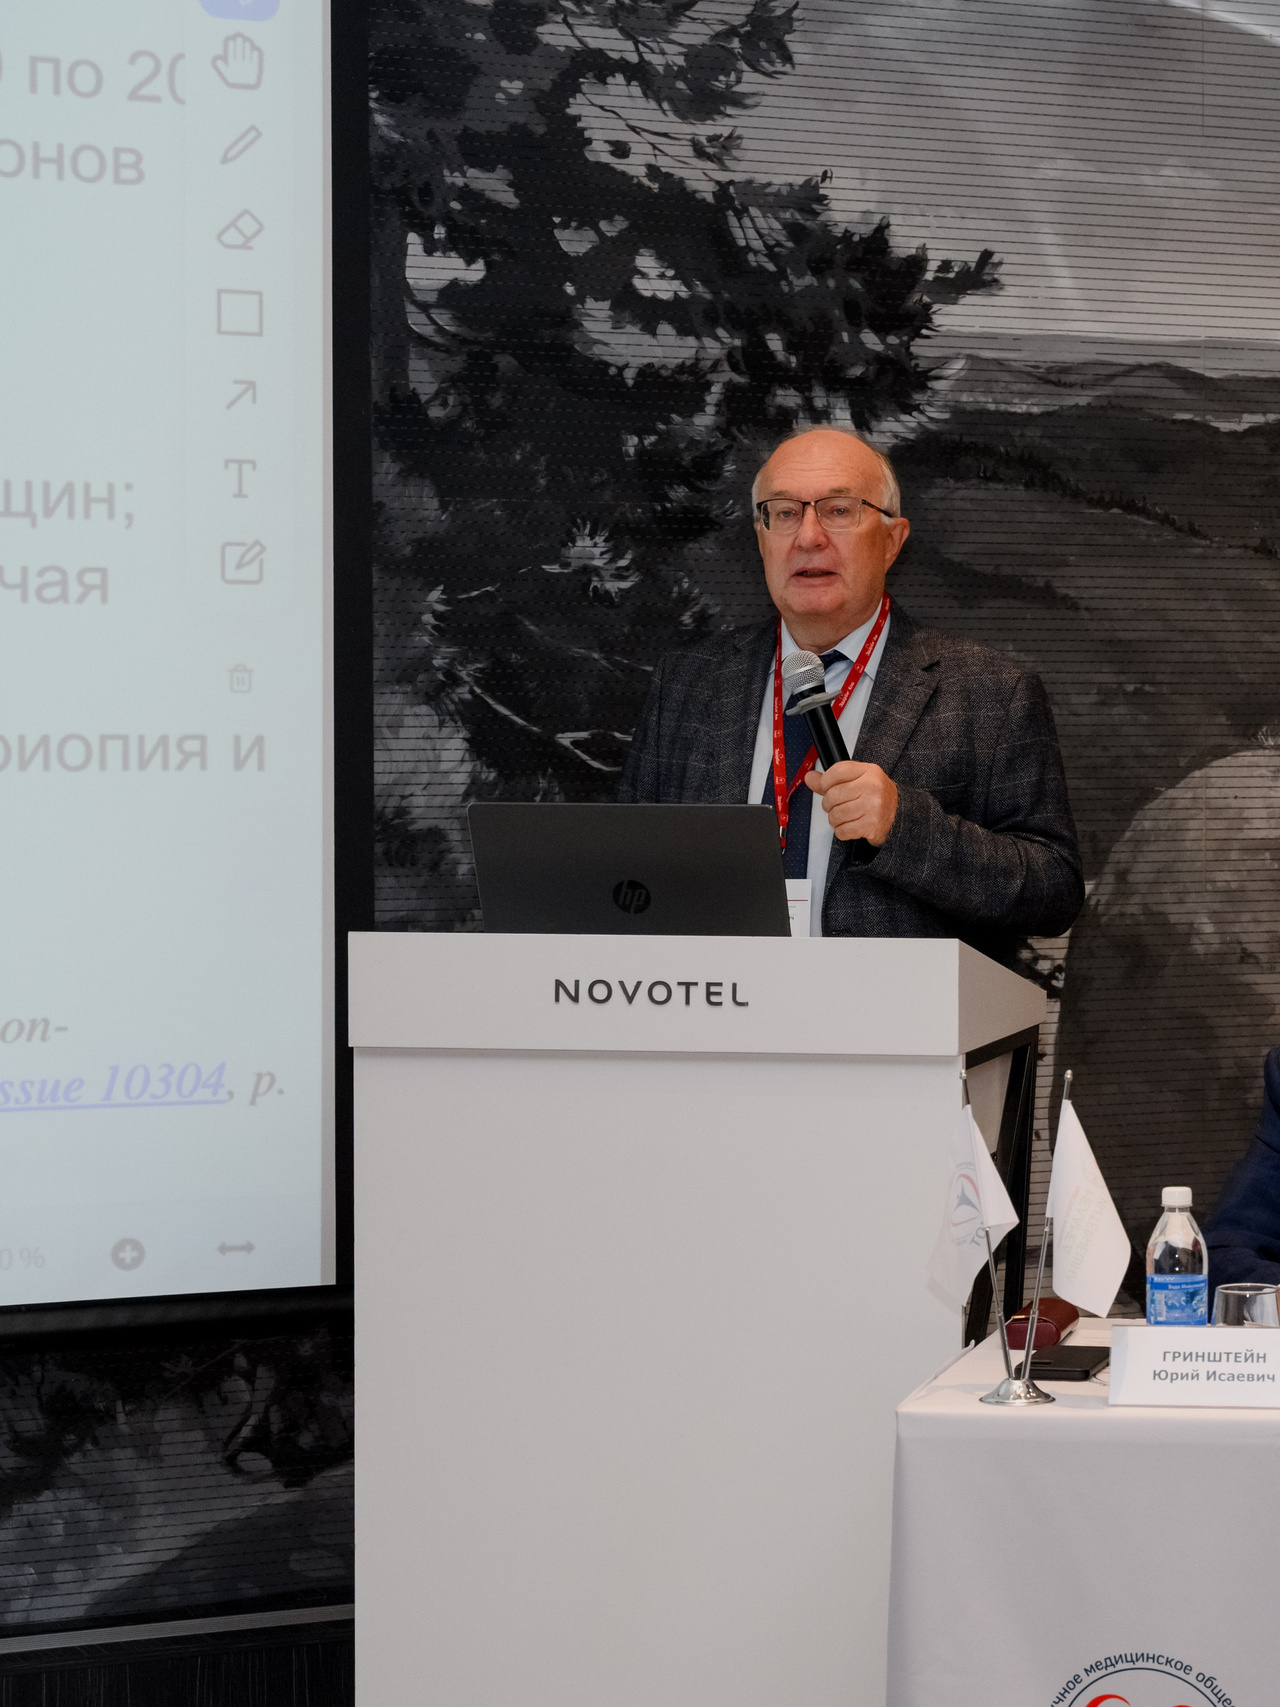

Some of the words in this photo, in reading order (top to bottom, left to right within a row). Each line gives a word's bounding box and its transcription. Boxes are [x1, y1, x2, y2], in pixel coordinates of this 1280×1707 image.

[29, 54, 104, 98] по
[0, 138, 146, 186] онов
[0, 479, 134, 530] щин;
[0, 565, 109, 605] чая
[233, 734, 266, 772] и
[616, 879, 649, 914] hp
[554, 978, 749, 1007] NOVOTEL
[0, 1017, 69, 1044] on-
[101, 1061, 234, 1103] 10304,
[249, 1071, 285, 1107] p.
[1152, 1369, 1200, 1383] Юрий
[1206, 1370, 1276, 1383] Исаевич
[1162, 1349, 1267, 1364] ГРИНШТЕЙН
[1050, 1674, 1083, 1707] чное
[1083, 1652, 1193, 1677] медицинское
[1195, 1672, 1235, 1707] обще
